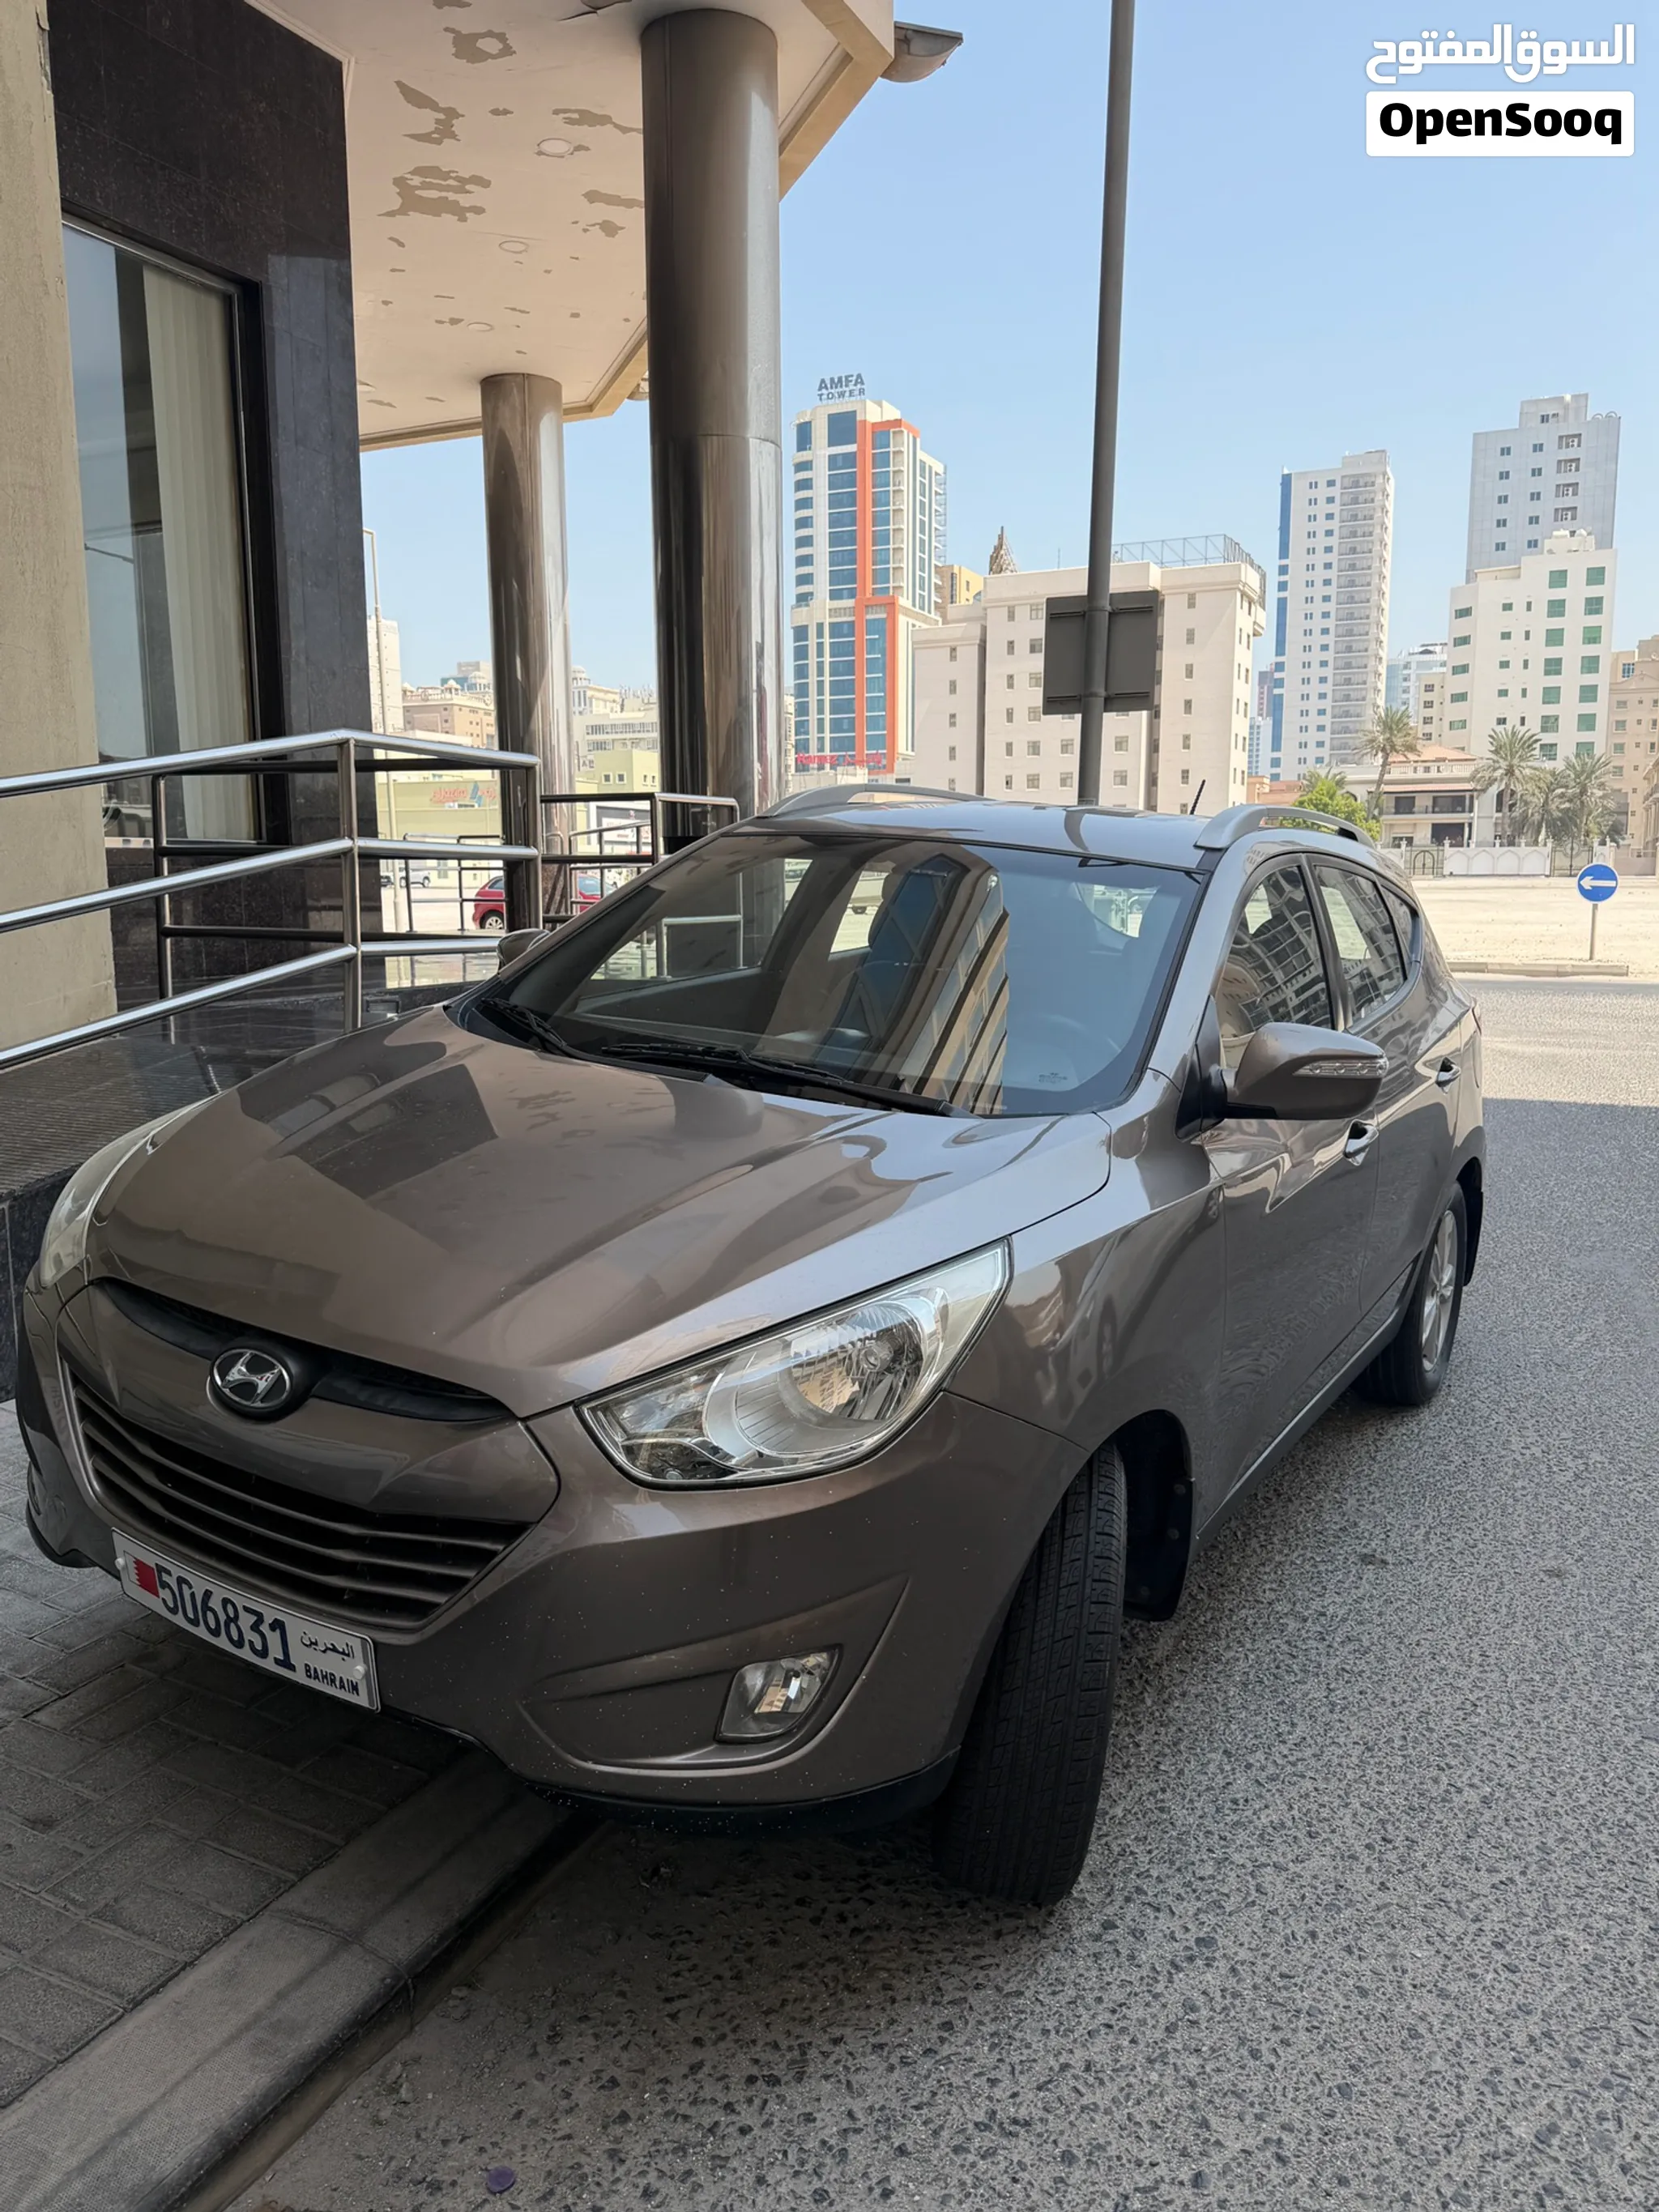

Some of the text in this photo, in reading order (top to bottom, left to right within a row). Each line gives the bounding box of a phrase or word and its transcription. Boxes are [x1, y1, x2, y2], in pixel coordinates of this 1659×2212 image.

[817, 373, 865, 392] AMFA
[817, 387, 865, 402] TOWER
[155, 1562, 296, 1673] 506831
[301, 1630, 355, 1662] البحرين
[304, 1662, 360, 1697] BAHRAIN
